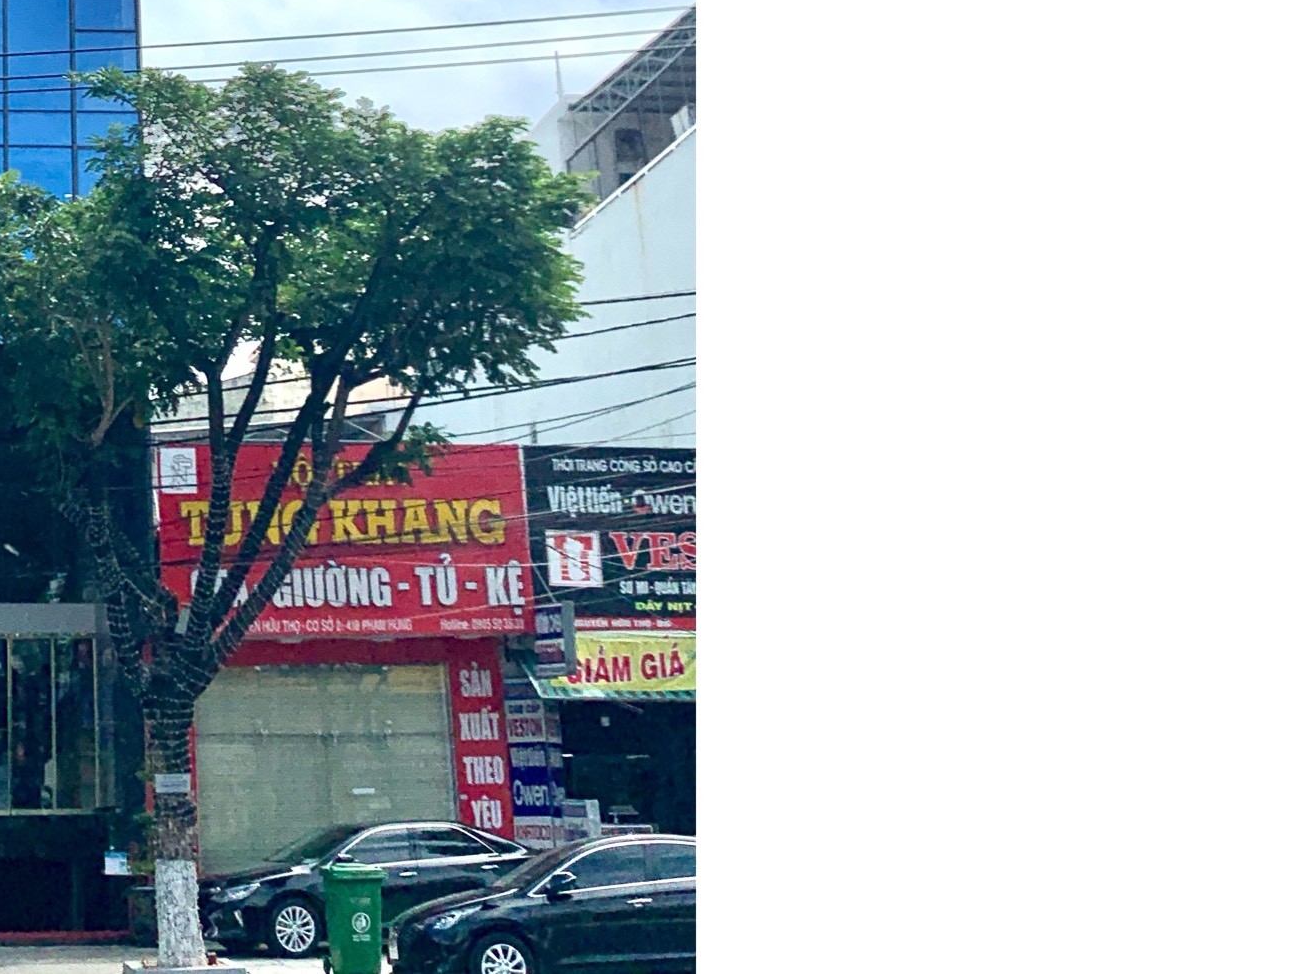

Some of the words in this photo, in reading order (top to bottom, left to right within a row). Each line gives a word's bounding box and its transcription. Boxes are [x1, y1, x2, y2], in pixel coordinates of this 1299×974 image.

[575, 459, 608, 472] TRANG
[660, 460, 682, 473] CAO
[330, 499, 505, 545] KHANG
[272, 560, 393, 608] GIƯỜNG
[414, 553, 458, 606] TỦ
[486, 560, 526, 615] KỆ
[459, 661, 493, 697] SẢN
[641, 642, 685, 680] GIÁ
[458, 705, 500, 741] XUẤT
[463, 756, 504, 784] THEO
[513, 779, 550, 806] Owen
[470, 797, 503, 829] YÊU
